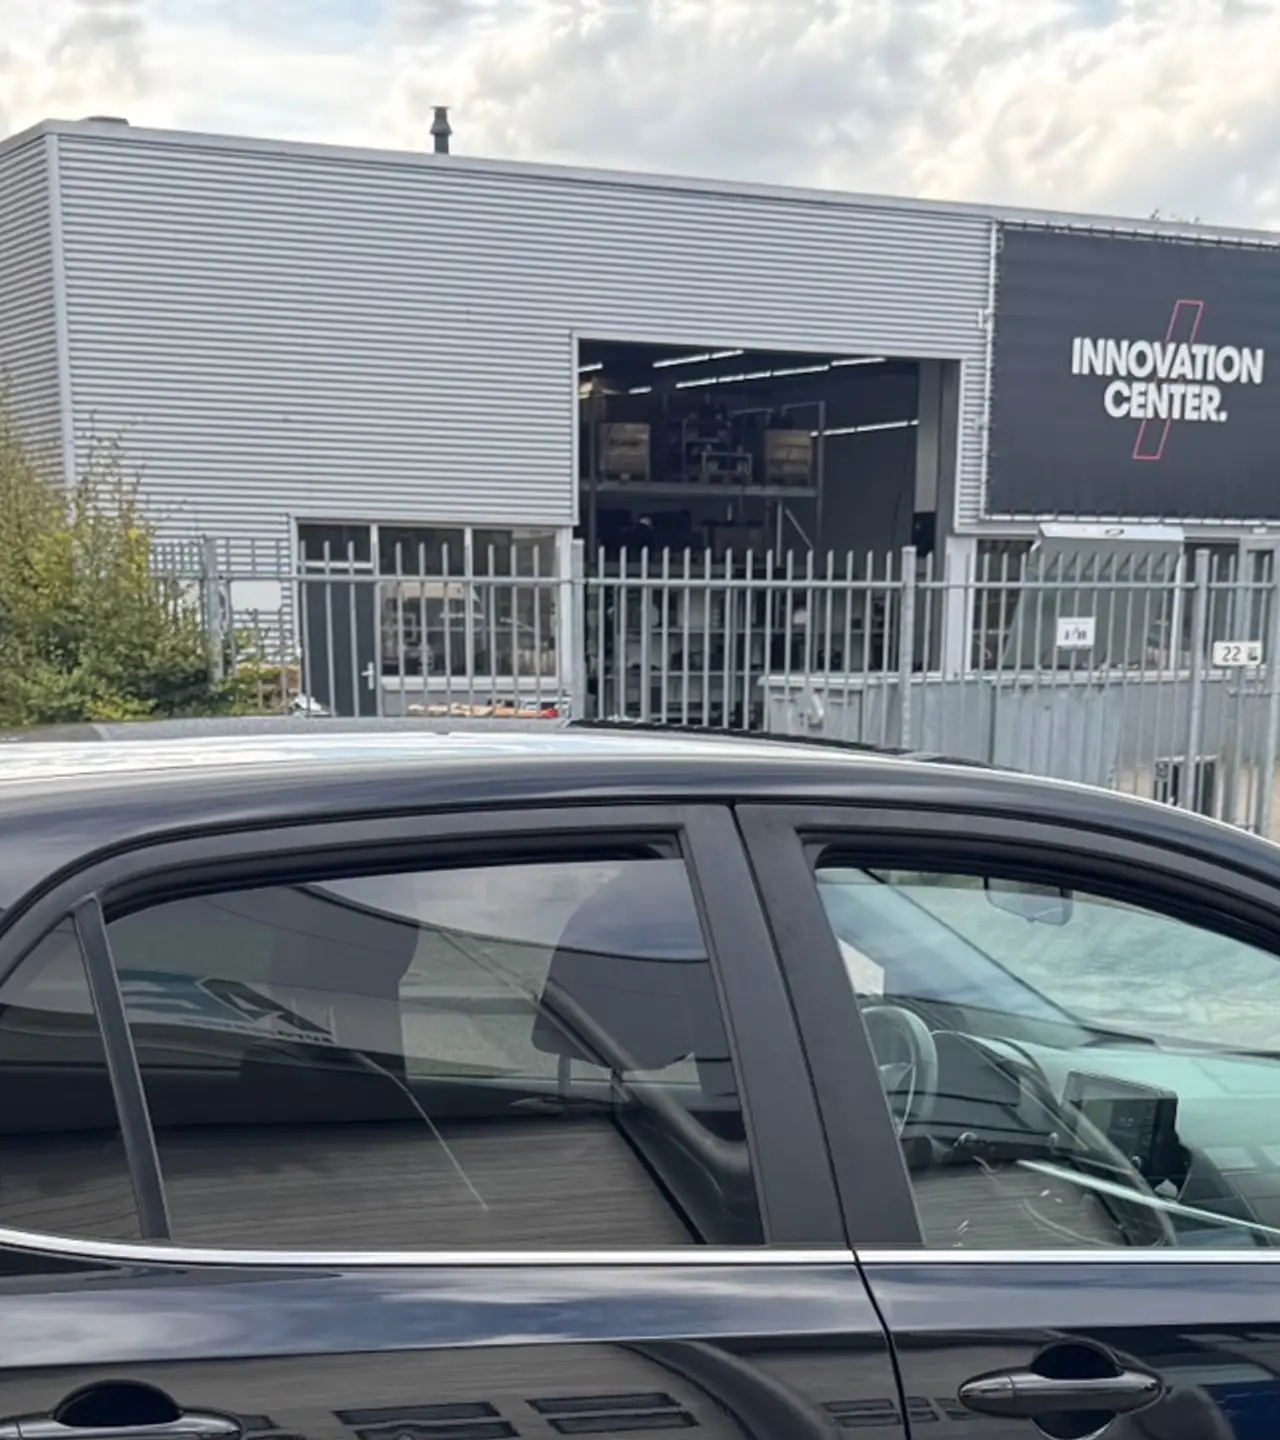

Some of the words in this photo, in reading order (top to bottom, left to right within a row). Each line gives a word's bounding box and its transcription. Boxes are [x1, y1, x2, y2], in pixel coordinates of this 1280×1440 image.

[1071, 336, 1265, 384] INNOVATION
[1104, 380, 1228, 422] CENTER.
[1222, 646, 1242, 662] 22
